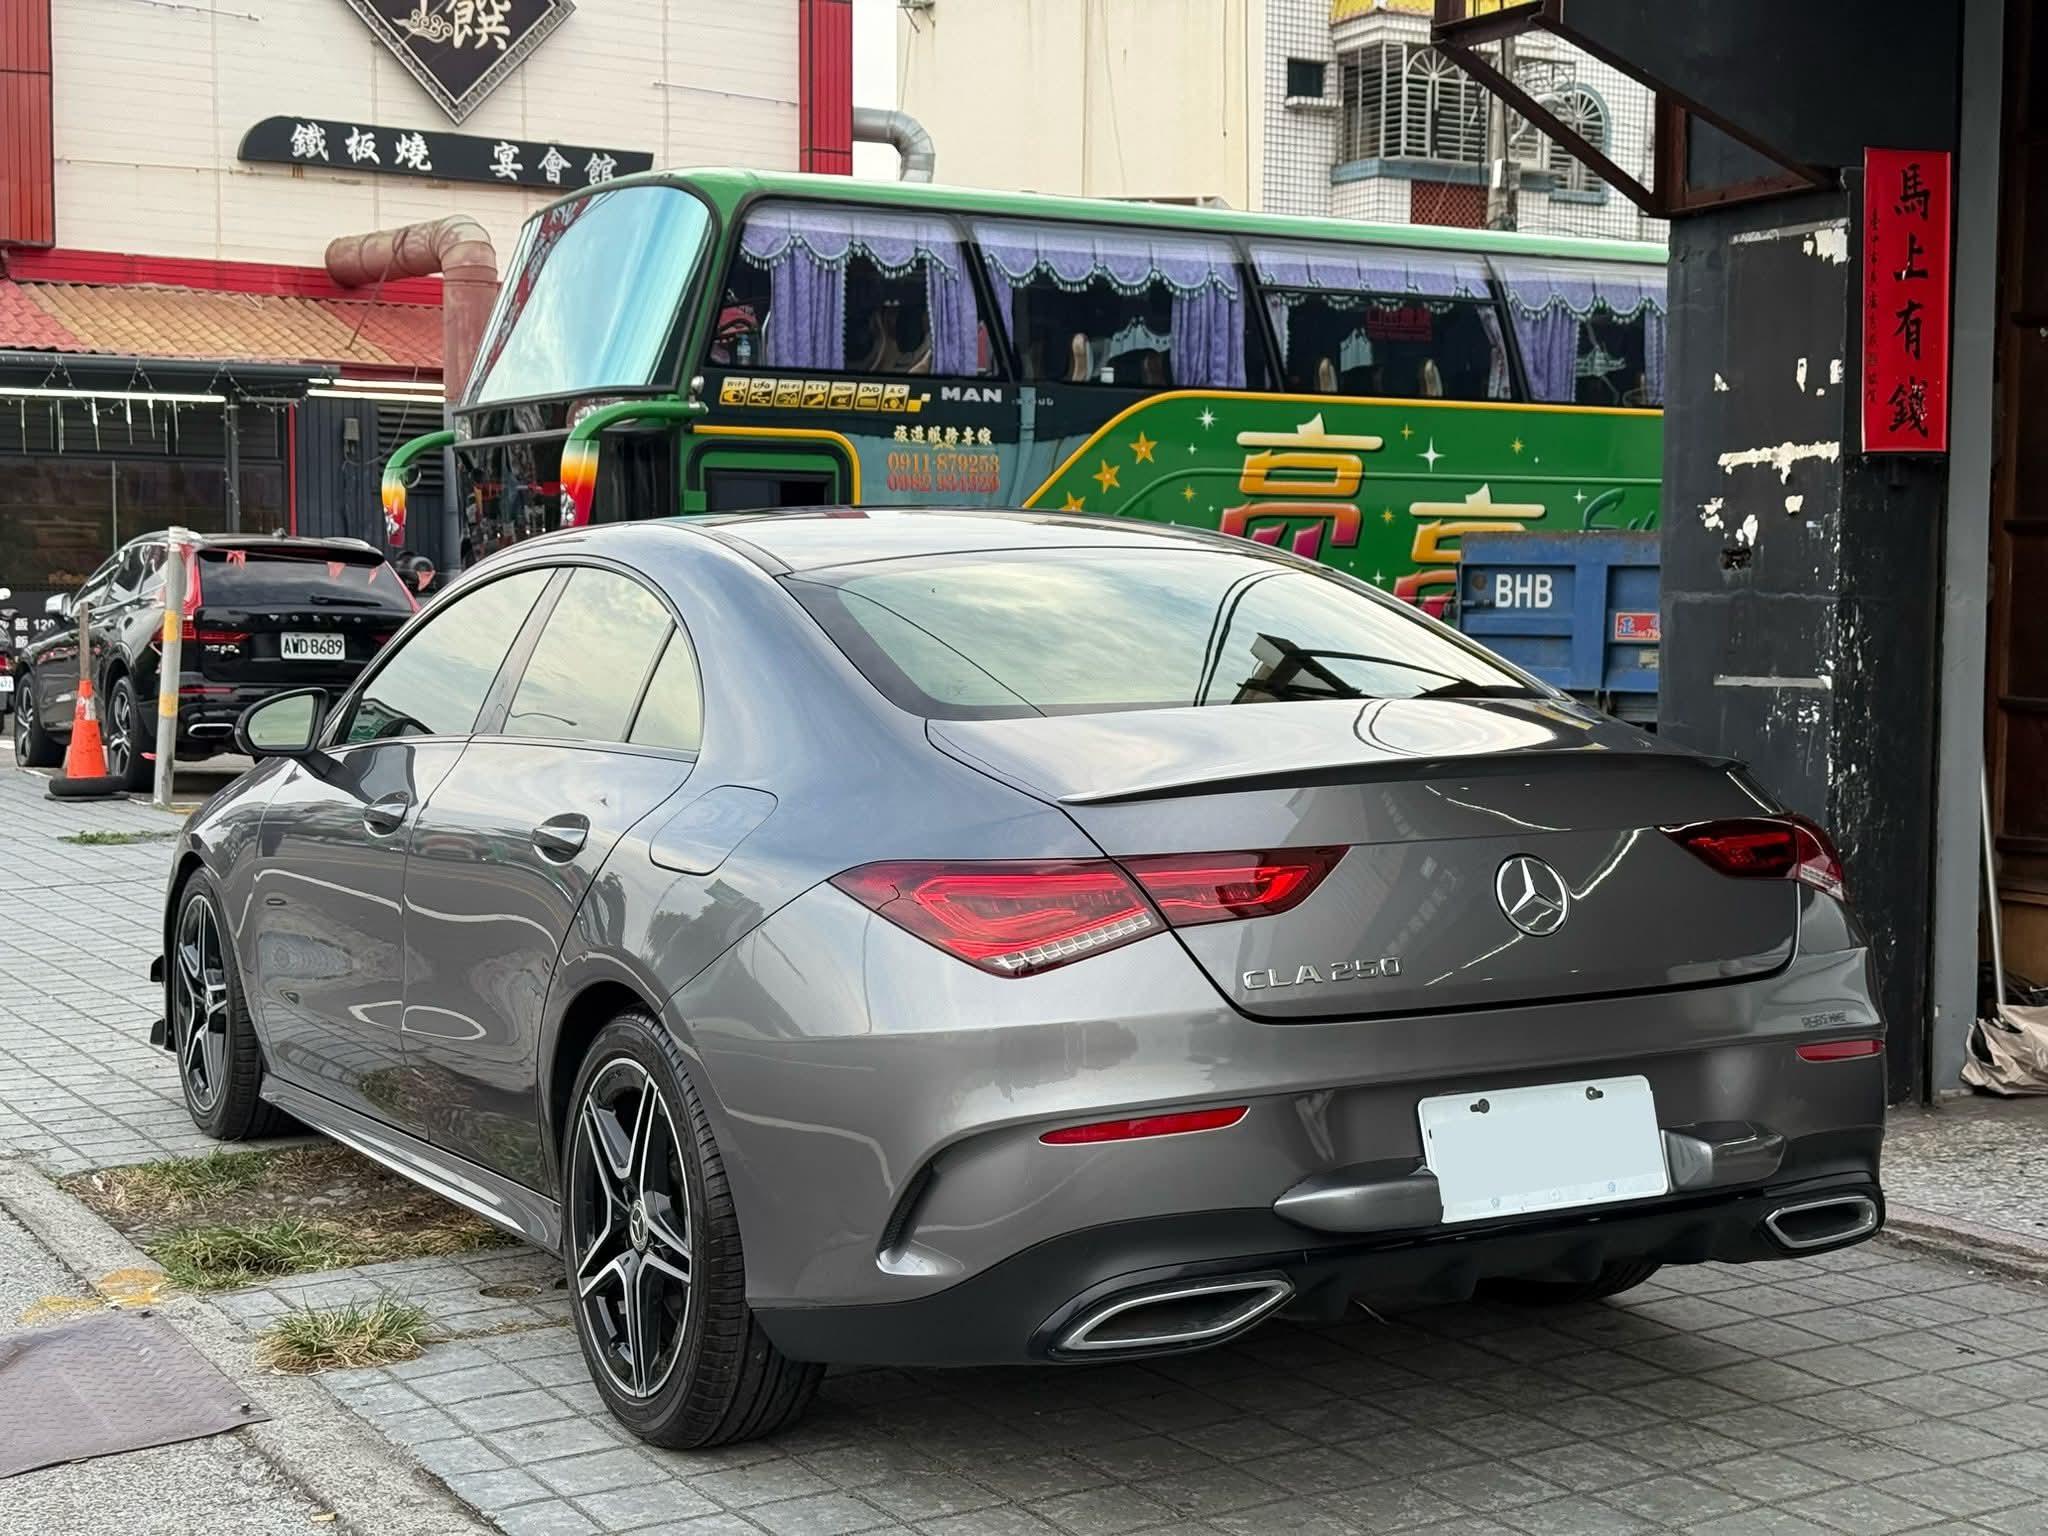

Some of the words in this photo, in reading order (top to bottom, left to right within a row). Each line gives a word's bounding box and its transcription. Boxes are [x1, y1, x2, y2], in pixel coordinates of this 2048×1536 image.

[290, 122, 433, 172] 鐵板燒
[488, 140, 618, 186] 宴會館
[1888, 162, 1931, 439] 馬上有錢
[941, 386, 1003, 403] MAN
[1494, 573, 1553, 608] BHB
[1242, 965, 1323, 990] CLA
[1330, 956, 1403, 981] 250
